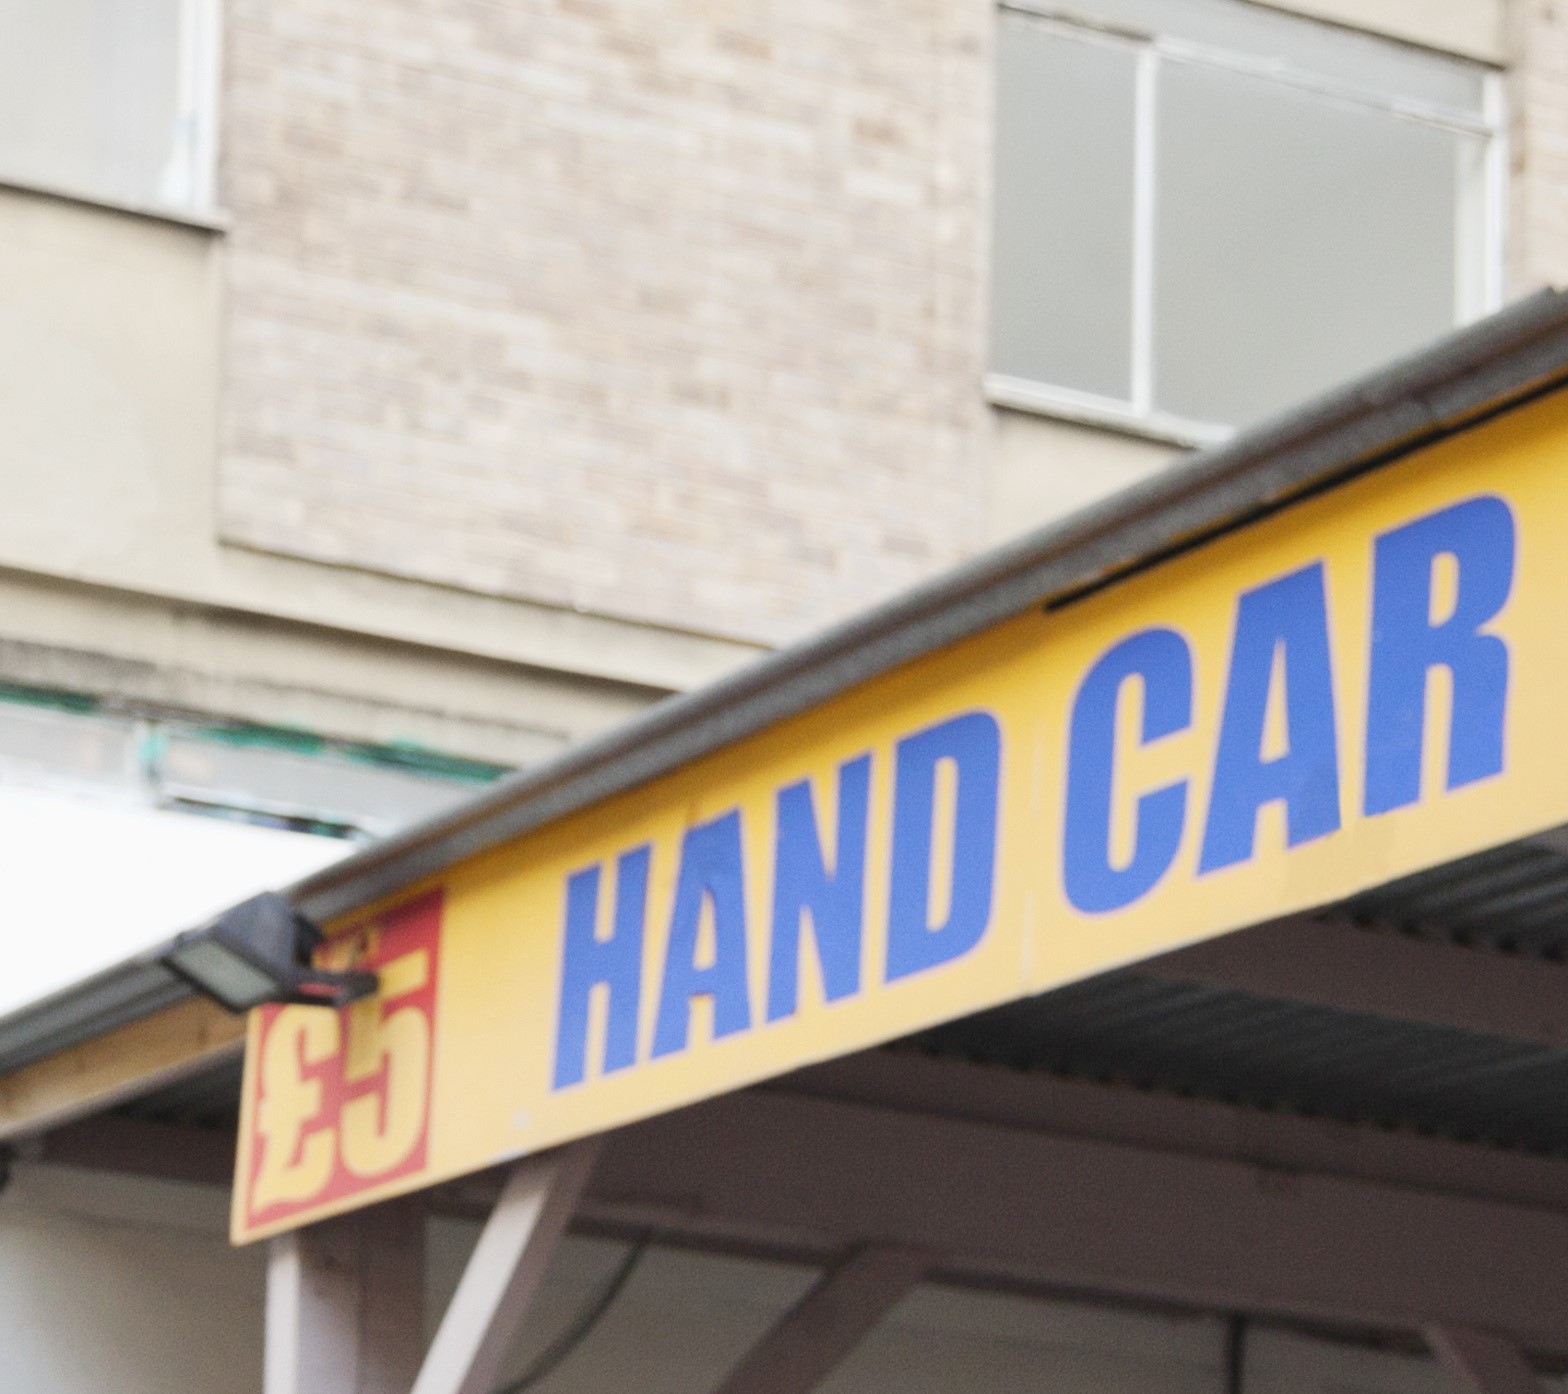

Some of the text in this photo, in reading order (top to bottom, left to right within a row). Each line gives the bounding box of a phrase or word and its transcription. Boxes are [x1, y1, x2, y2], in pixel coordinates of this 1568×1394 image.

[550, 705, 1004, 1095] HAND
[1064, 492, 1518, 917] CAR
[252, 946, 431, 1216] £5
